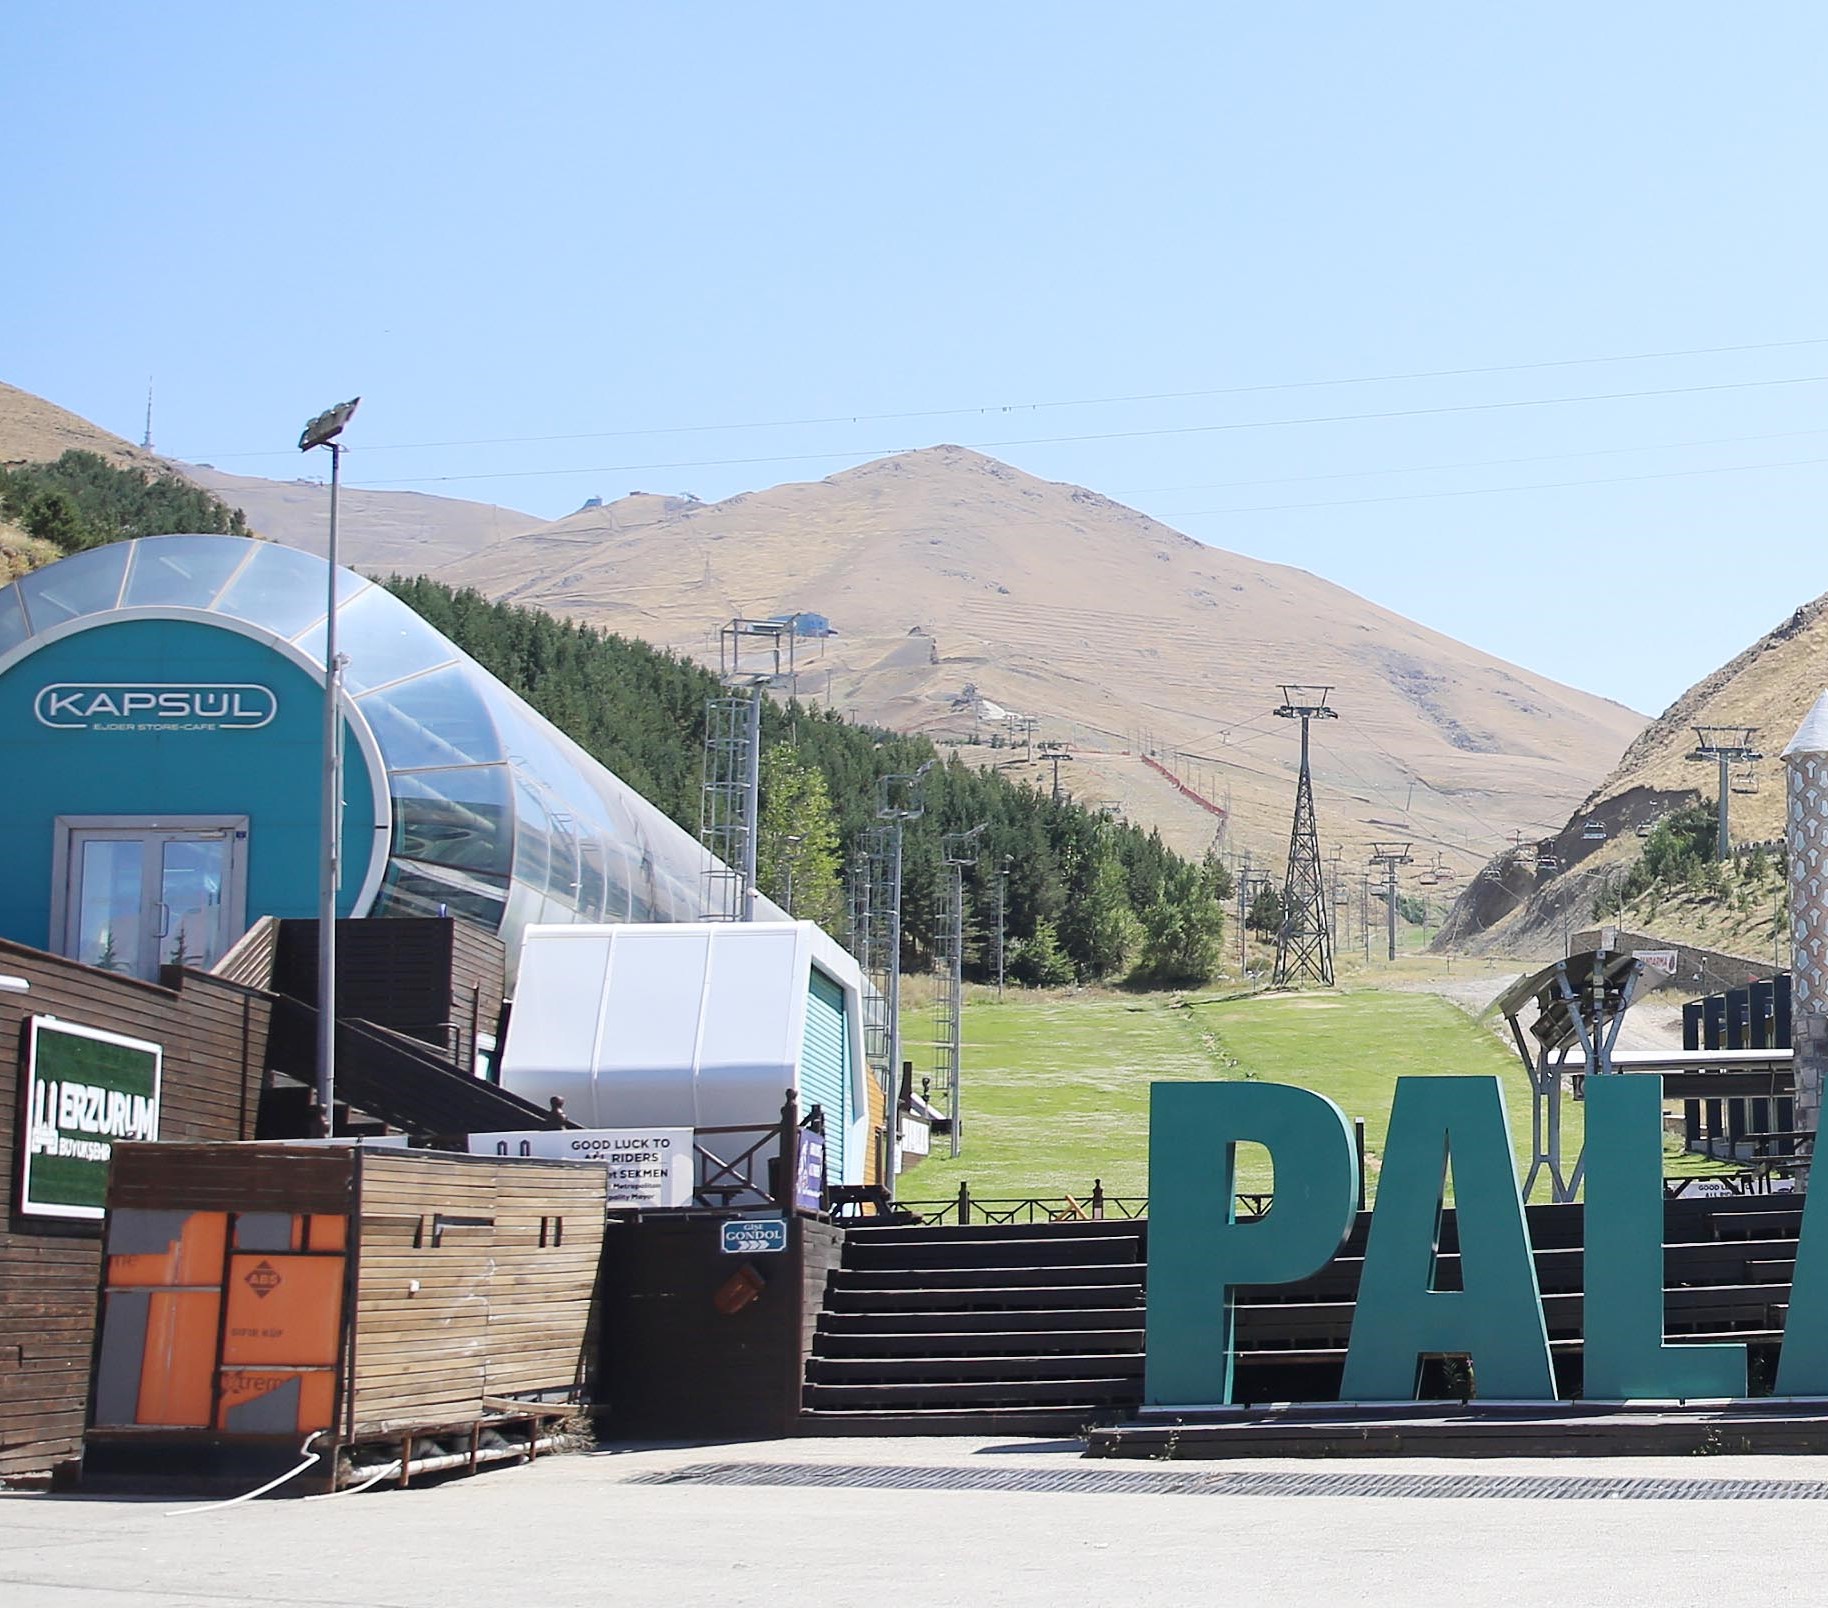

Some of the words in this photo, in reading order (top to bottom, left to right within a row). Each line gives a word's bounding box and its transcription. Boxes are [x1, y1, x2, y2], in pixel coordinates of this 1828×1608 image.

[58, 1080, 156, 1142] ERZURUM
[571, 1140, 611, 1151] GOOD
[615, 1139, 649, 1149] LUCK
[652, 1138, 671, 1148] TO
[612, 1153, 659, 1163] RIDERS
[620, 1168, 668, 1179] SEKMEN
[725, 1231, 782, 1241] GONDOL
